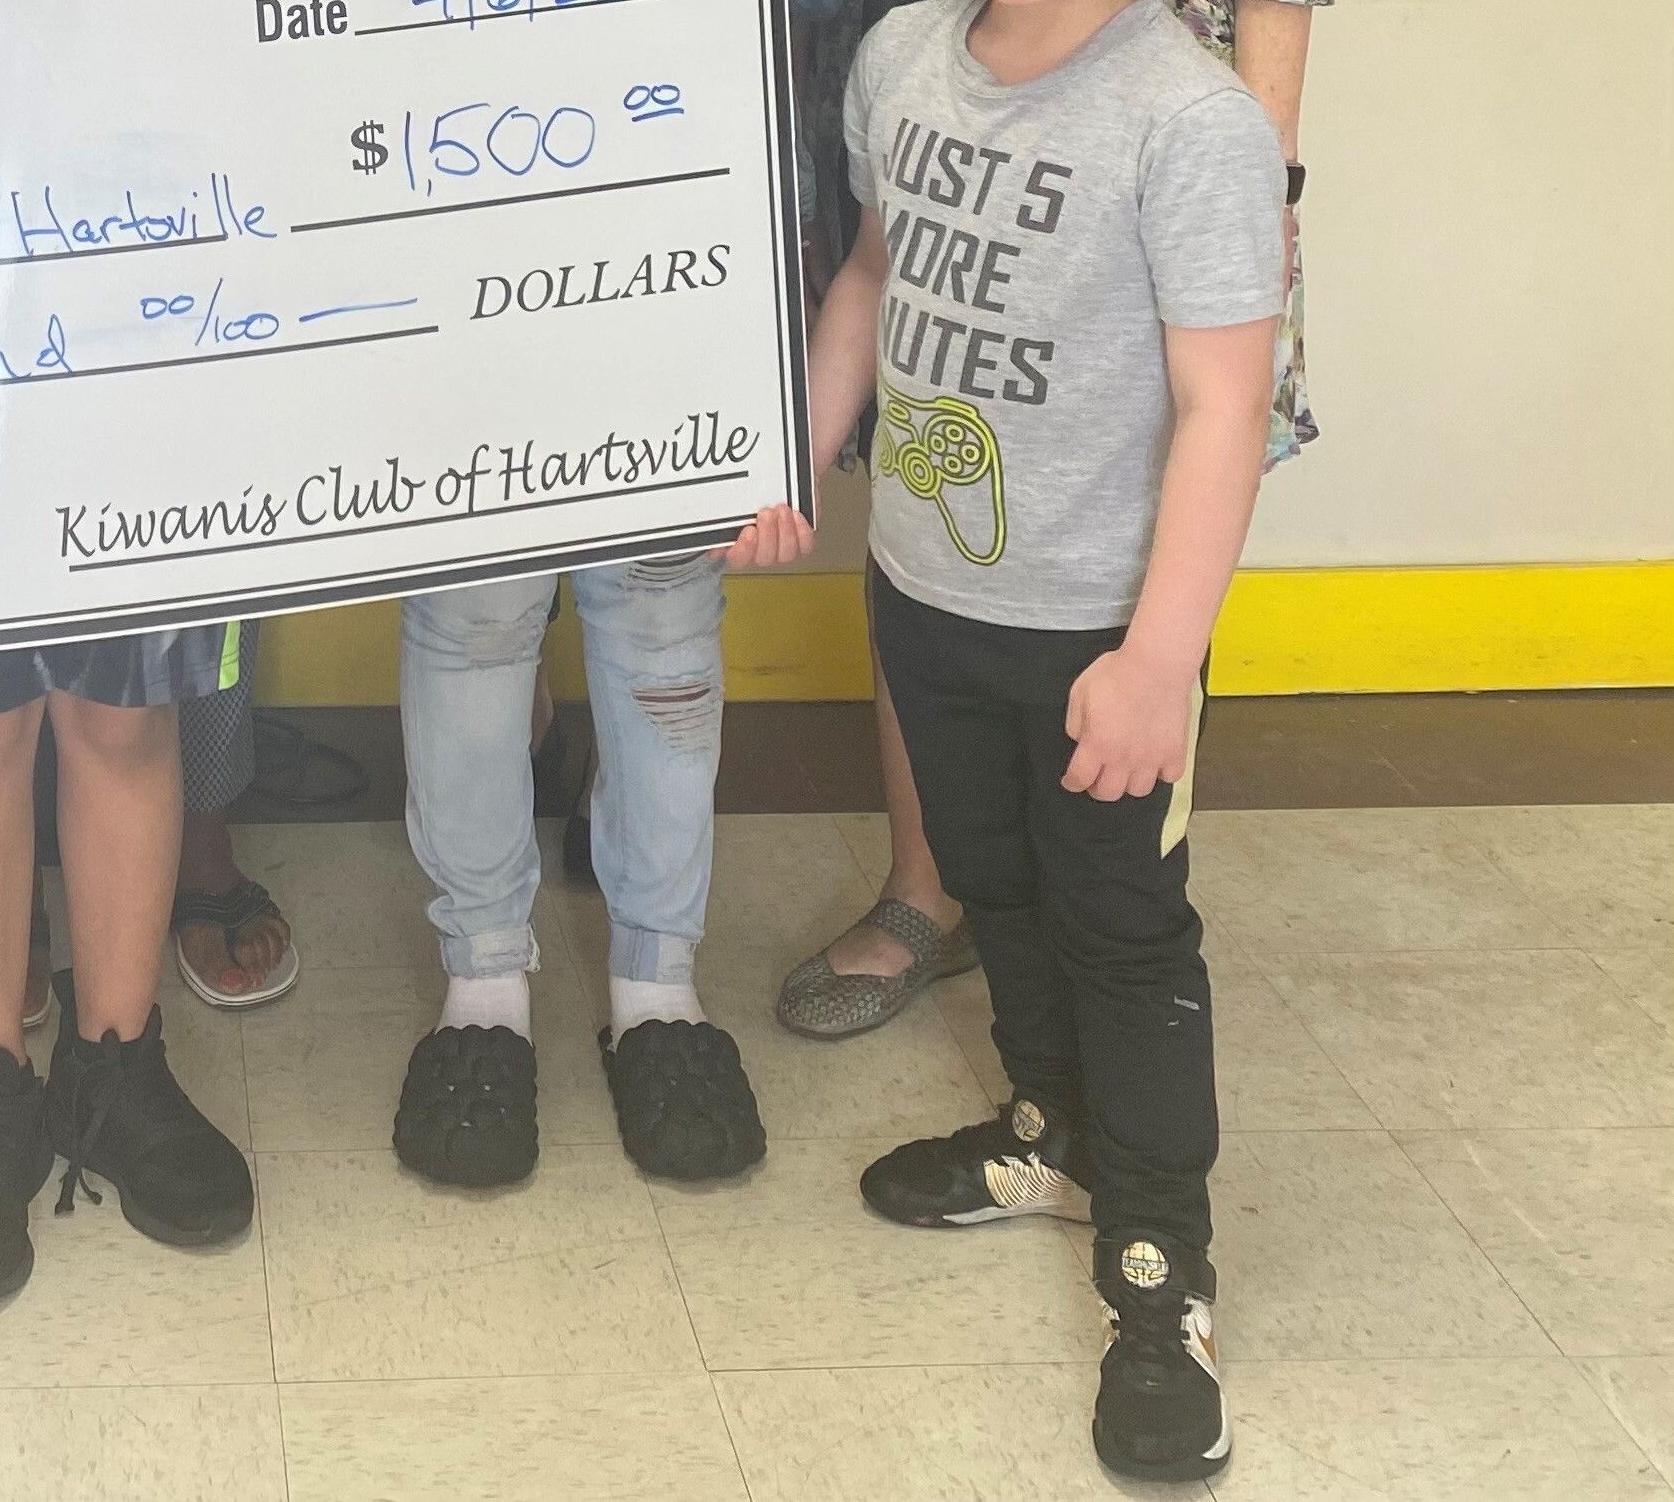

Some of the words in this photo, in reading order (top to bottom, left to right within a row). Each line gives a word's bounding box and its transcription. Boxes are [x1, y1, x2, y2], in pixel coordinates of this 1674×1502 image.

[882, 118, 1012, 215] JUST
[1016, 161, 1073, 234] 5
[470, 243, 731, 320] DOLLARS
[56, 483, 287, 559] Kiwanis
[296, 457, 424, 521] Club
[434, 445, 490, 515] of
[494, 411, 761, 503] Hartsville
